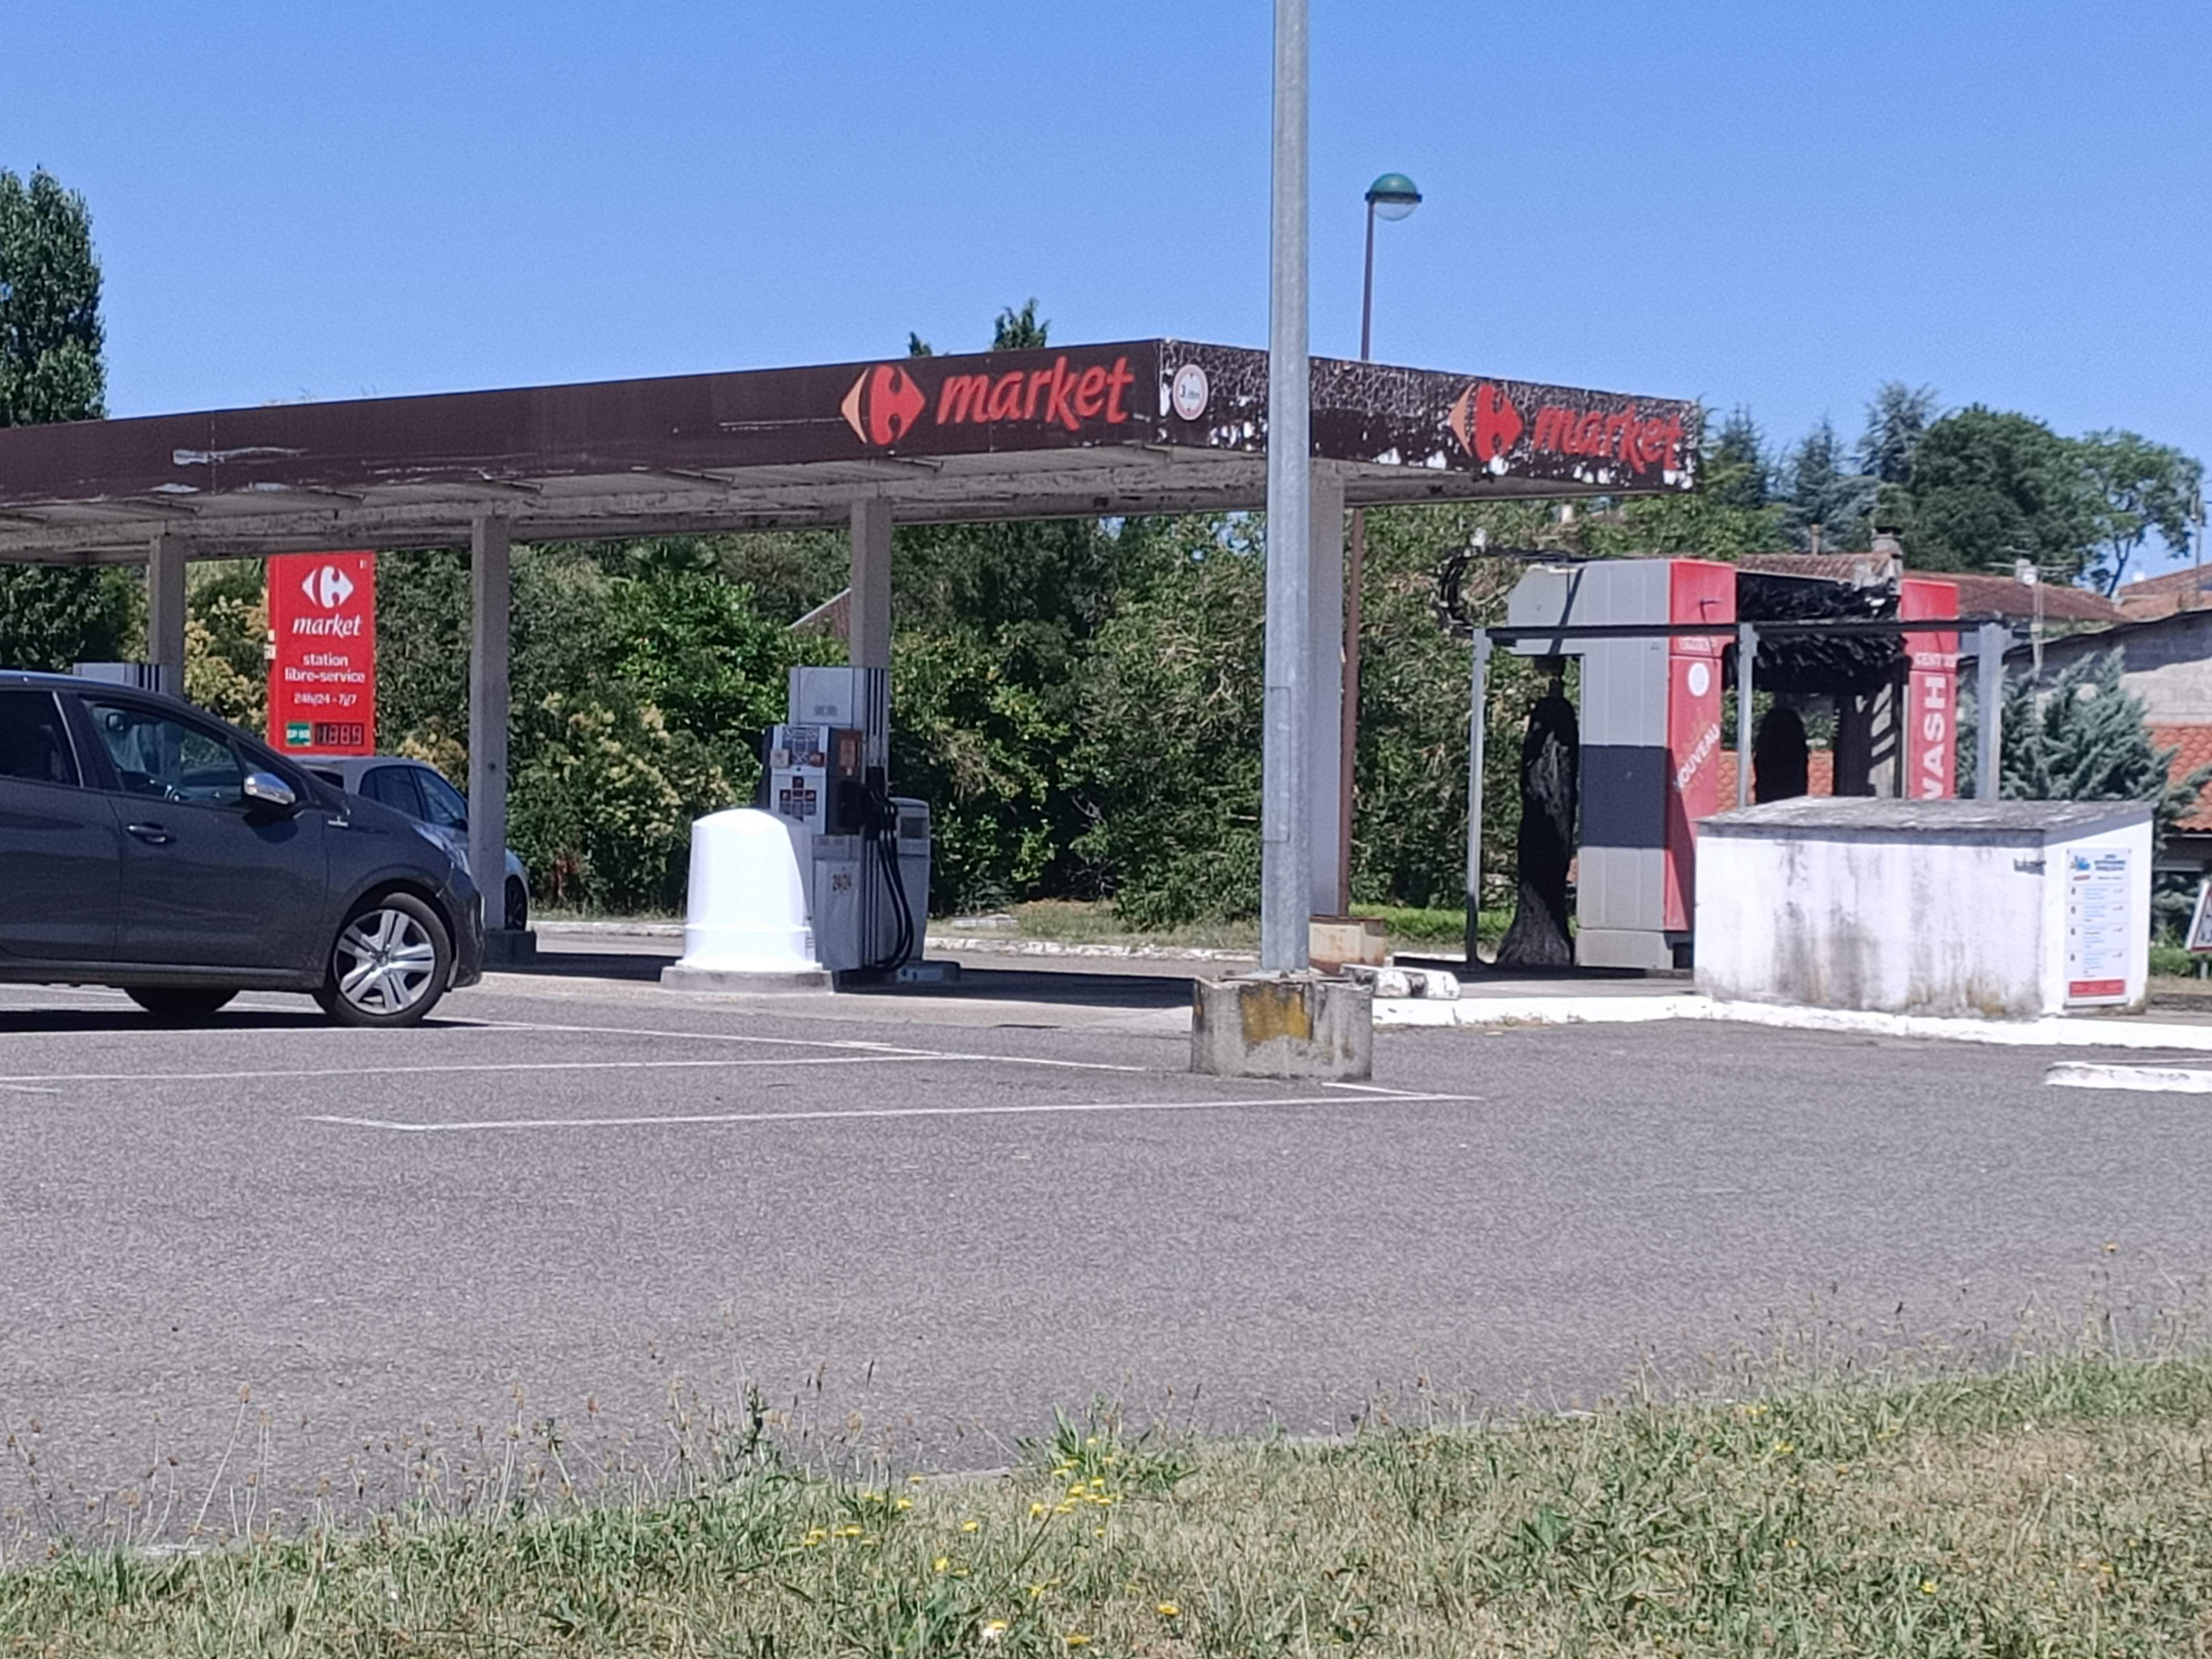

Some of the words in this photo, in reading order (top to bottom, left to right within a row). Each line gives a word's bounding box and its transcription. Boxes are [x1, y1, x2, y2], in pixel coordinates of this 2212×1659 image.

[937, 355, 1134, 431] market
[1532, 405, 1685, 474] market
[292, 613, 363, 638] market
[302, 653, 348, 666] station
[285, 667, 366, 683] libre-service
